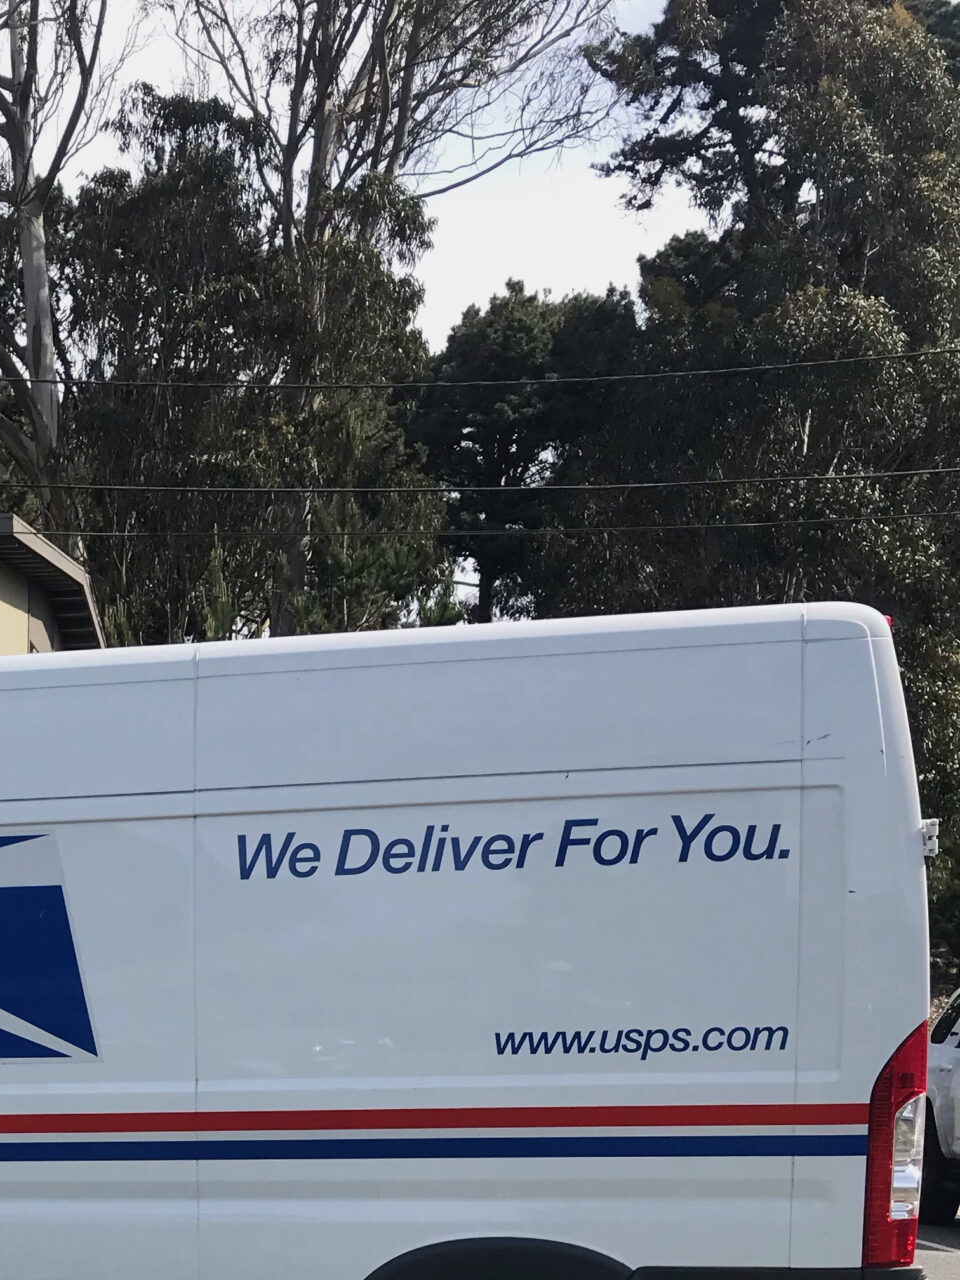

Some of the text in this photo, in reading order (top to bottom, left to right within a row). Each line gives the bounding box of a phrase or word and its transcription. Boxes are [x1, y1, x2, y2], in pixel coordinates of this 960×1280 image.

[236, 812, 792, 881] We Deliver For You.
[494, 1025, 790, 1061] www.usps.com
